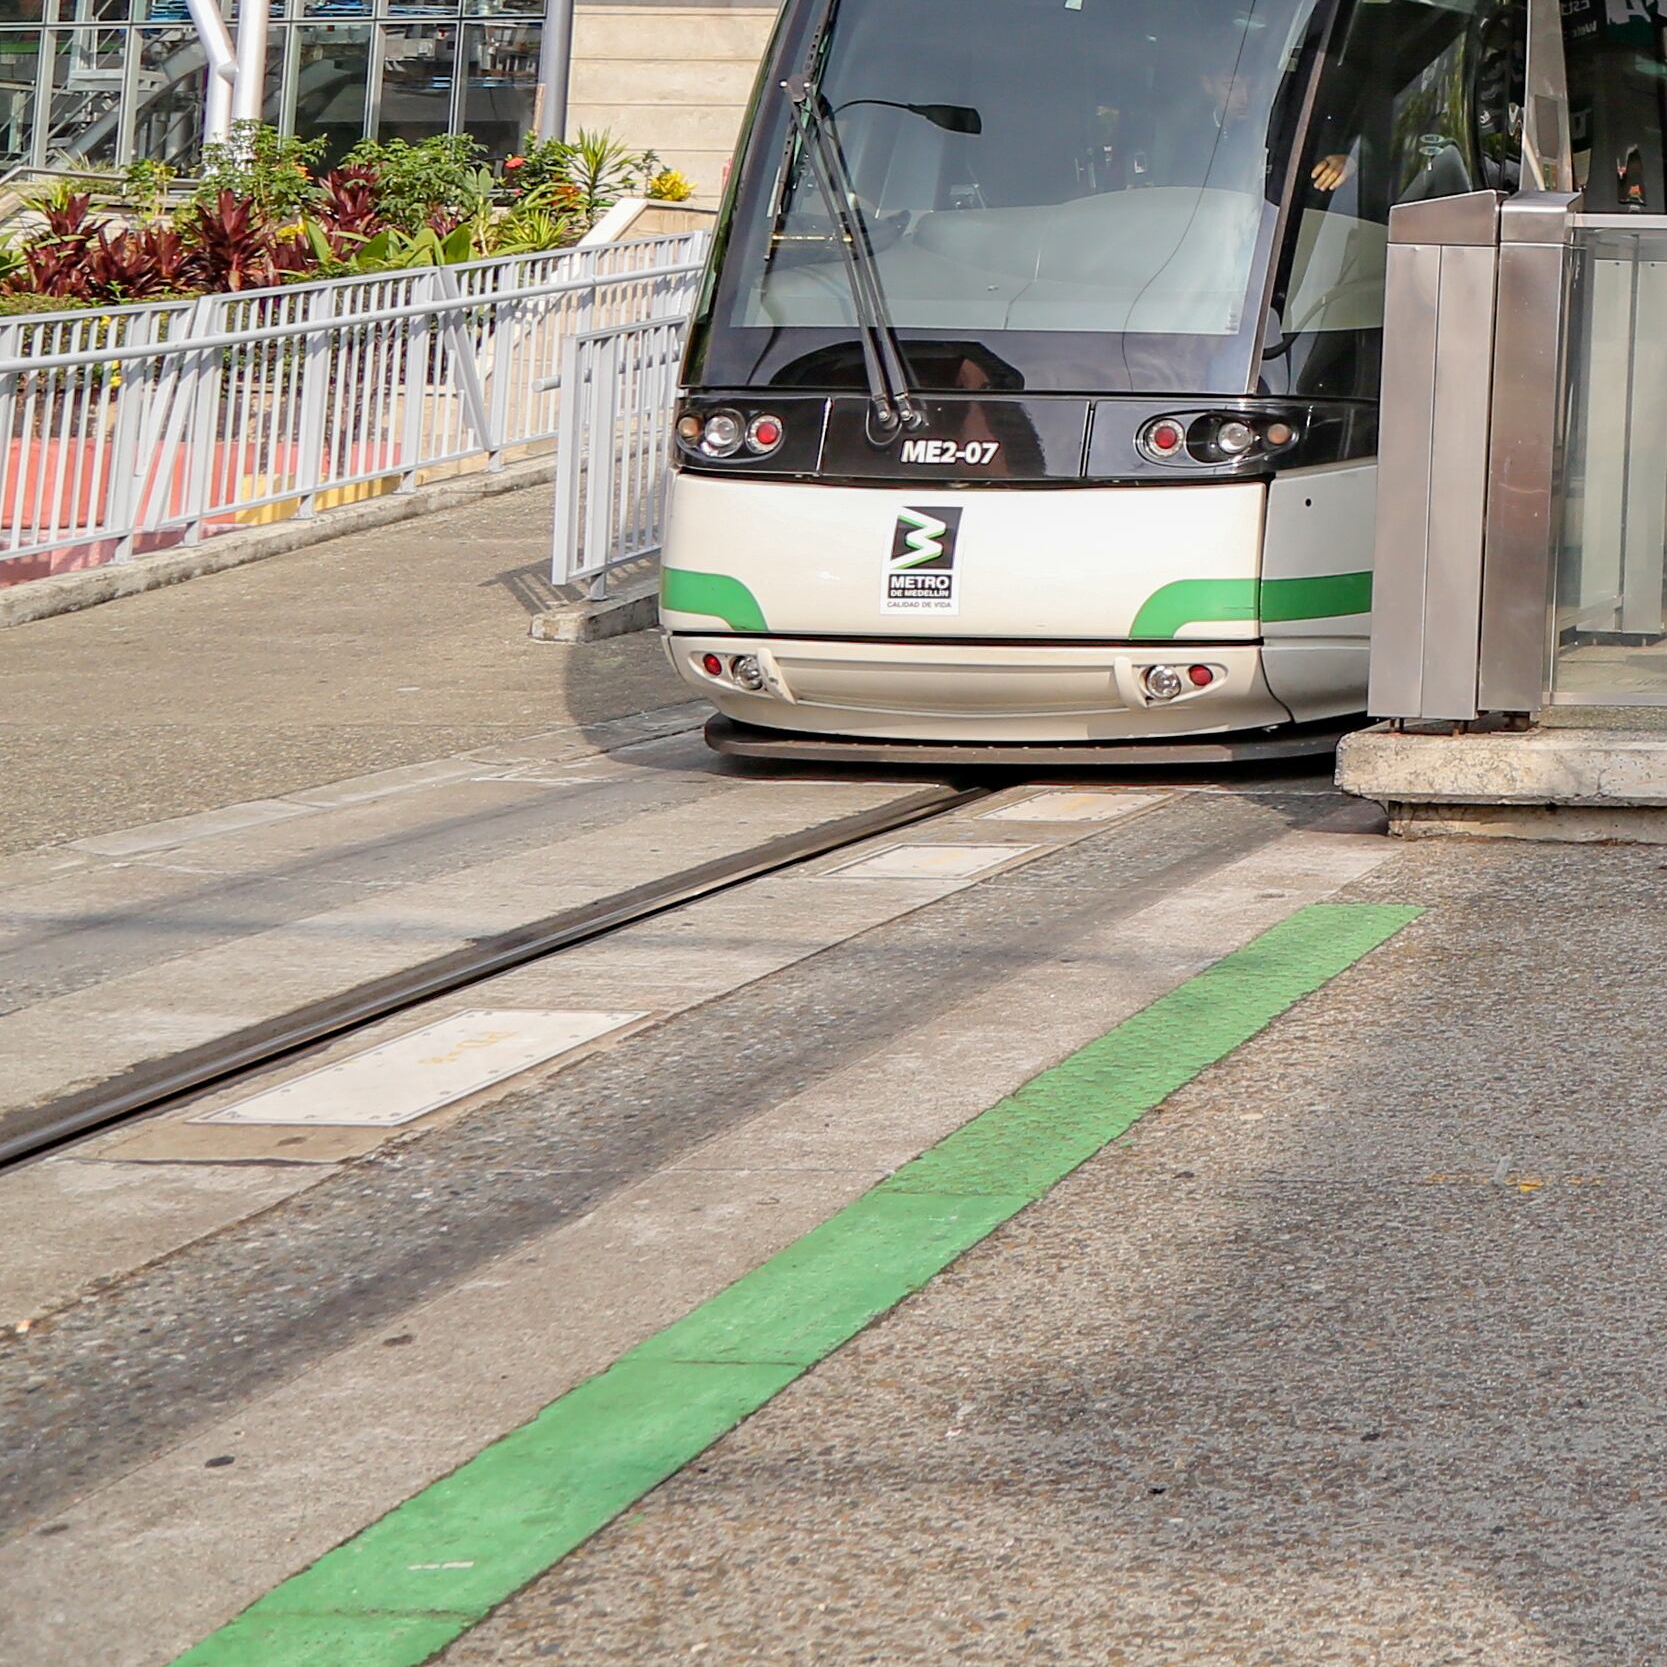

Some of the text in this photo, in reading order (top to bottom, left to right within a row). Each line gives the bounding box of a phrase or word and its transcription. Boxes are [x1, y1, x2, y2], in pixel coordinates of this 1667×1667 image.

[901, 440, 1000, 466] ME2-07
[891, 575, 950, 589] METRO
[891, 589, 903, 597] DE
